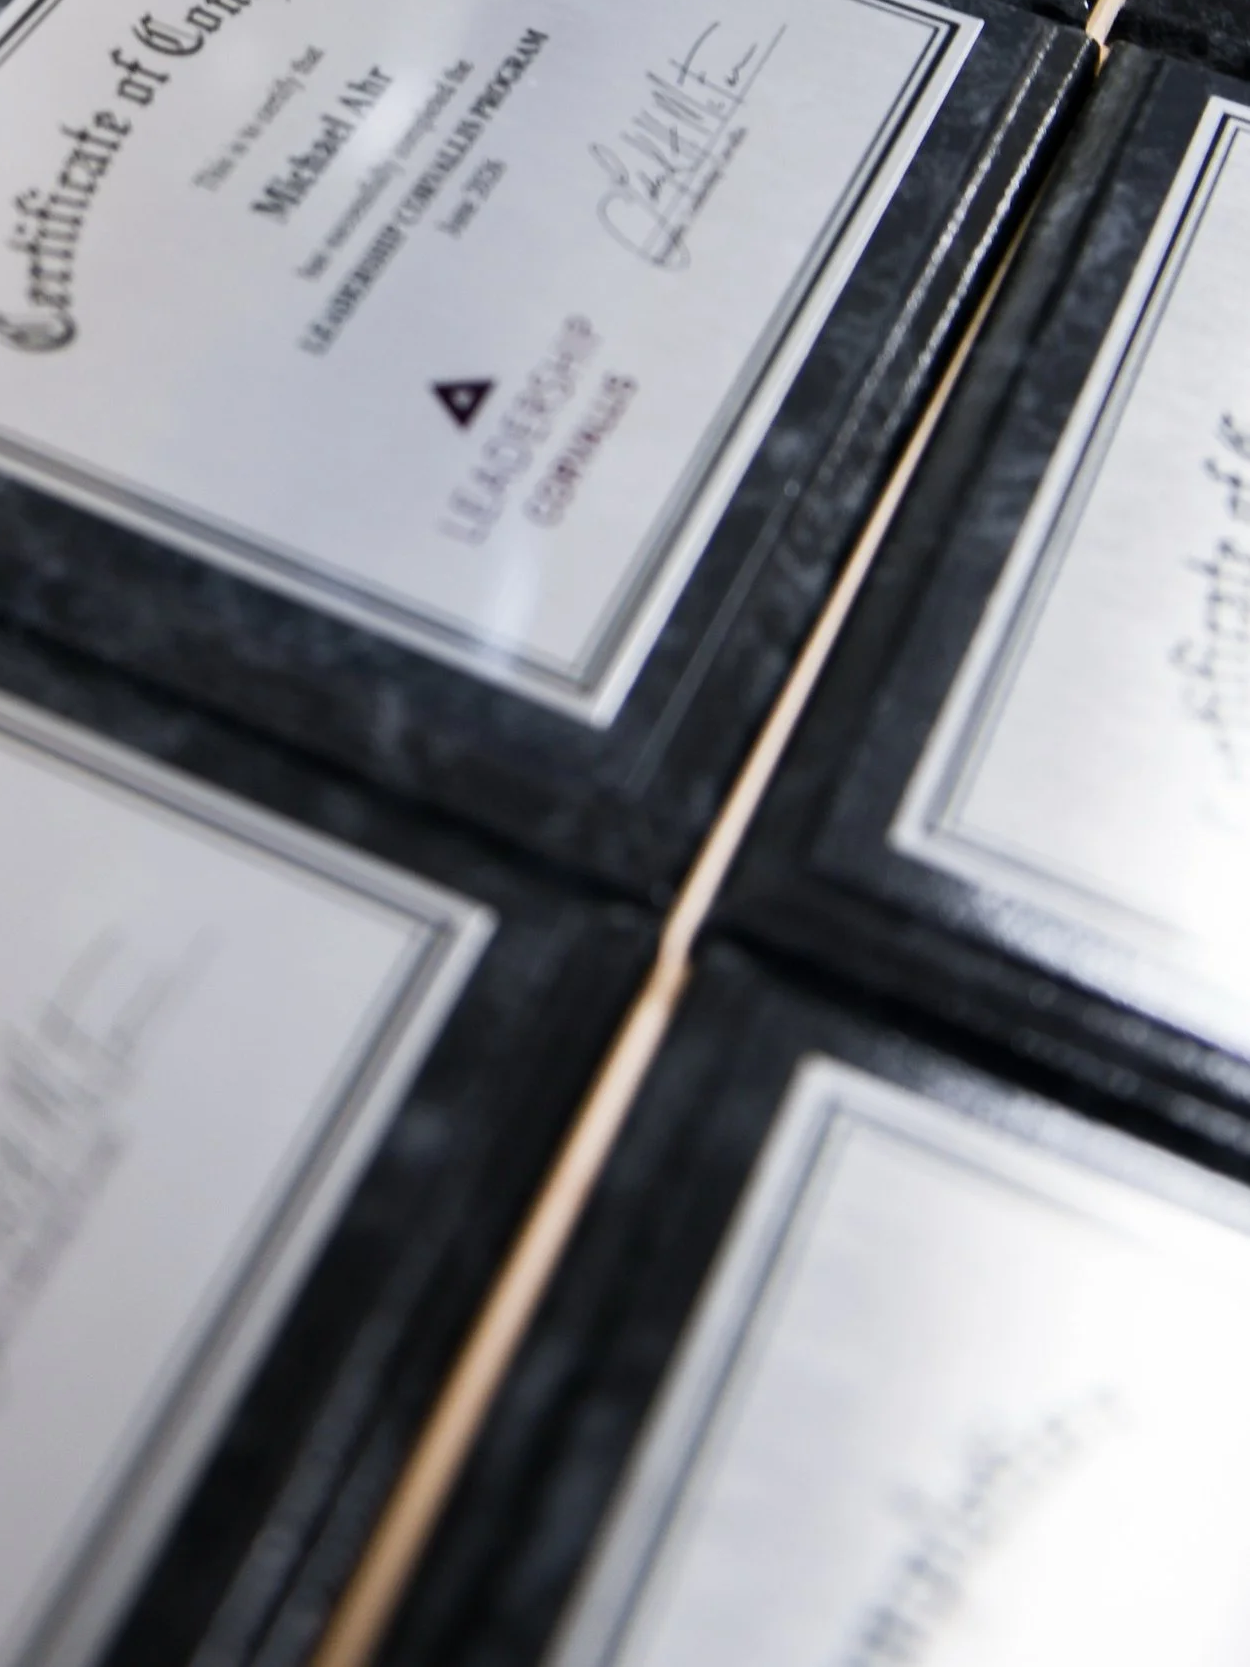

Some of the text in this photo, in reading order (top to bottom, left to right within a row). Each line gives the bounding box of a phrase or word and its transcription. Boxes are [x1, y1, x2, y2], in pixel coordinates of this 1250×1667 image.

[109, 47, 171, 107] of
[250, 64, 393, 225] Michael Ahr
[392, 119, 483, 227] CORVALLIS
[468, 27, 549, 121] PROGRAM
